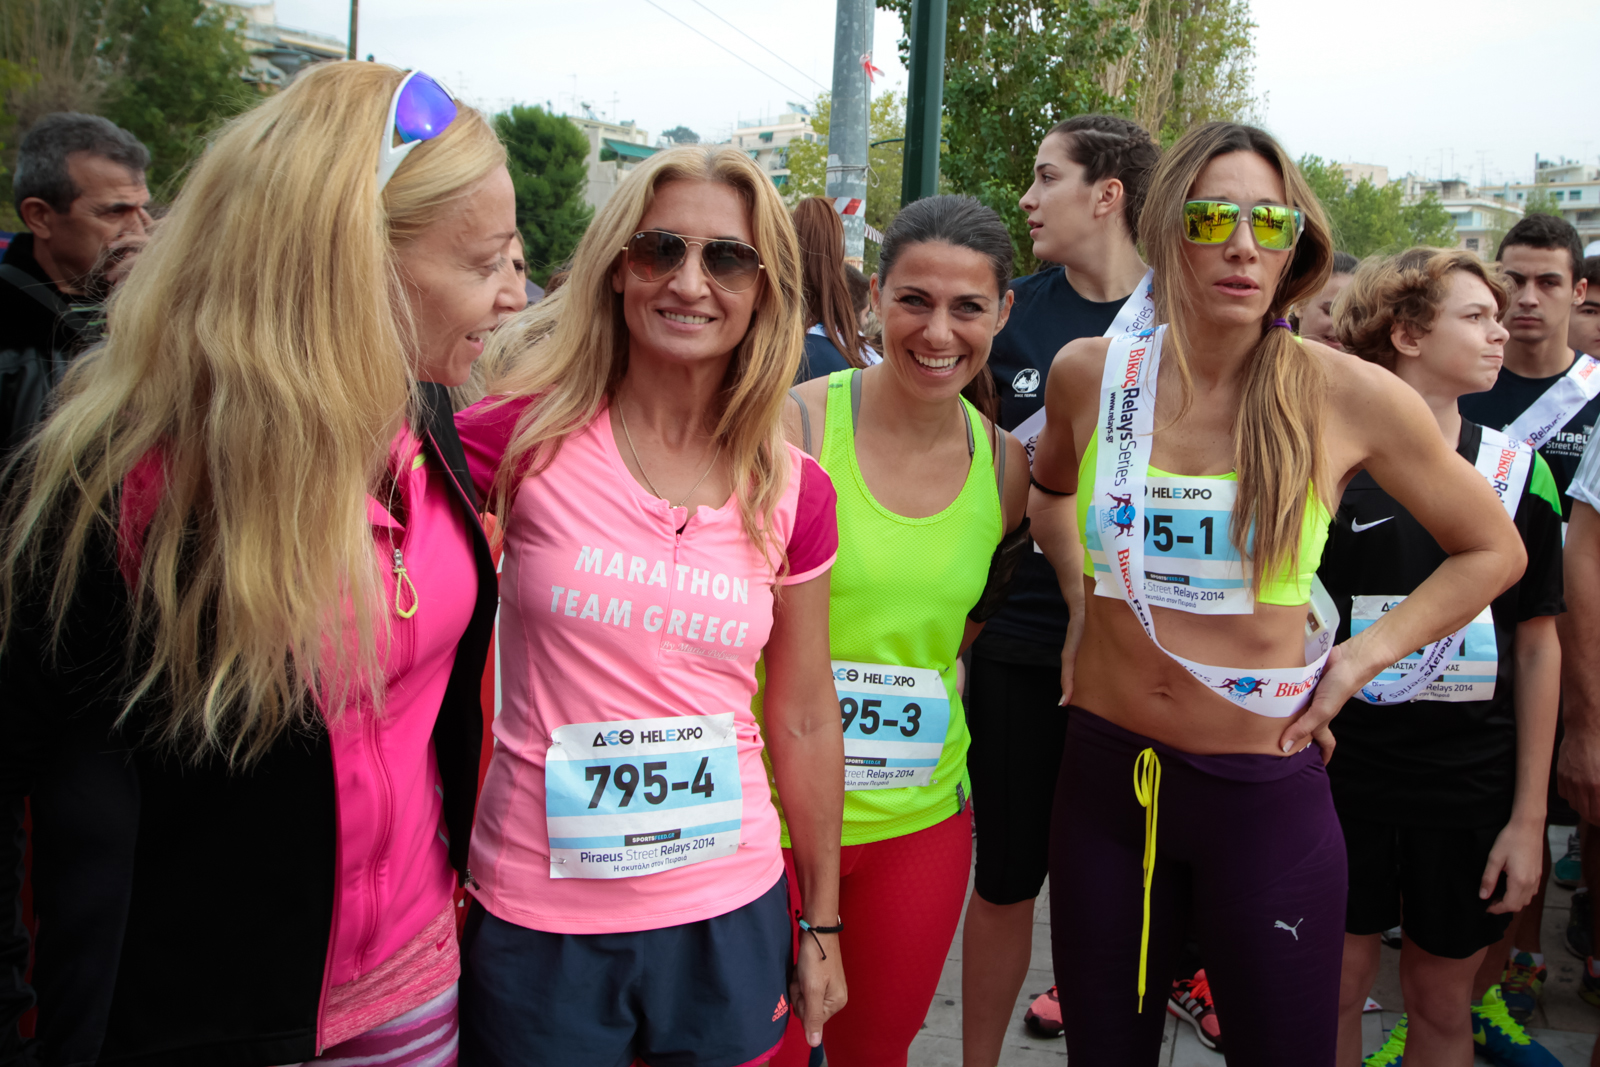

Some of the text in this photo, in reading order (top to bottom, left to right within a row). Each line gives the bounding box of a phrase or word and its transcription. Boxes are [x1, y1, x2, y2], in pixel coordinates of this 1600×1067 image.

[1546, 441, 1571, 450] Street
[1556, 431, 1591, 445] iraeu
[1152, 487, 1212, 500] HELEXPO
[1145, 515, 1213, 555] 5-1
[574, 545, 749, 605] MARATHON
[1148, 581, 1172, 595] Street
[1173, 586, 1199, 601] Relays
[1200, 591, 1225, 601] 2014
[550, 585, 749, 648] TEAM GREECE
[863, 672, 915, 688] HELEXPO
[1426, 684, 1473, 693] Relays 2014
[839, 697, 922, 738] 95-3
[640, 726, 703, 744] HELEXPO
[584, 756, 715, 810] 795-4
[844, 769, 914, 780] treet Relays 2014
[632, 832, 675, 844] SPORTSFEED.GR
[580, 836, 715, 863] Piraeus Street Relays 2014
[620, 862, 650, 873] σκυτάλη
[651, 860, 664, 868] στον
[664, 855, 688, 867] Πειραιά
